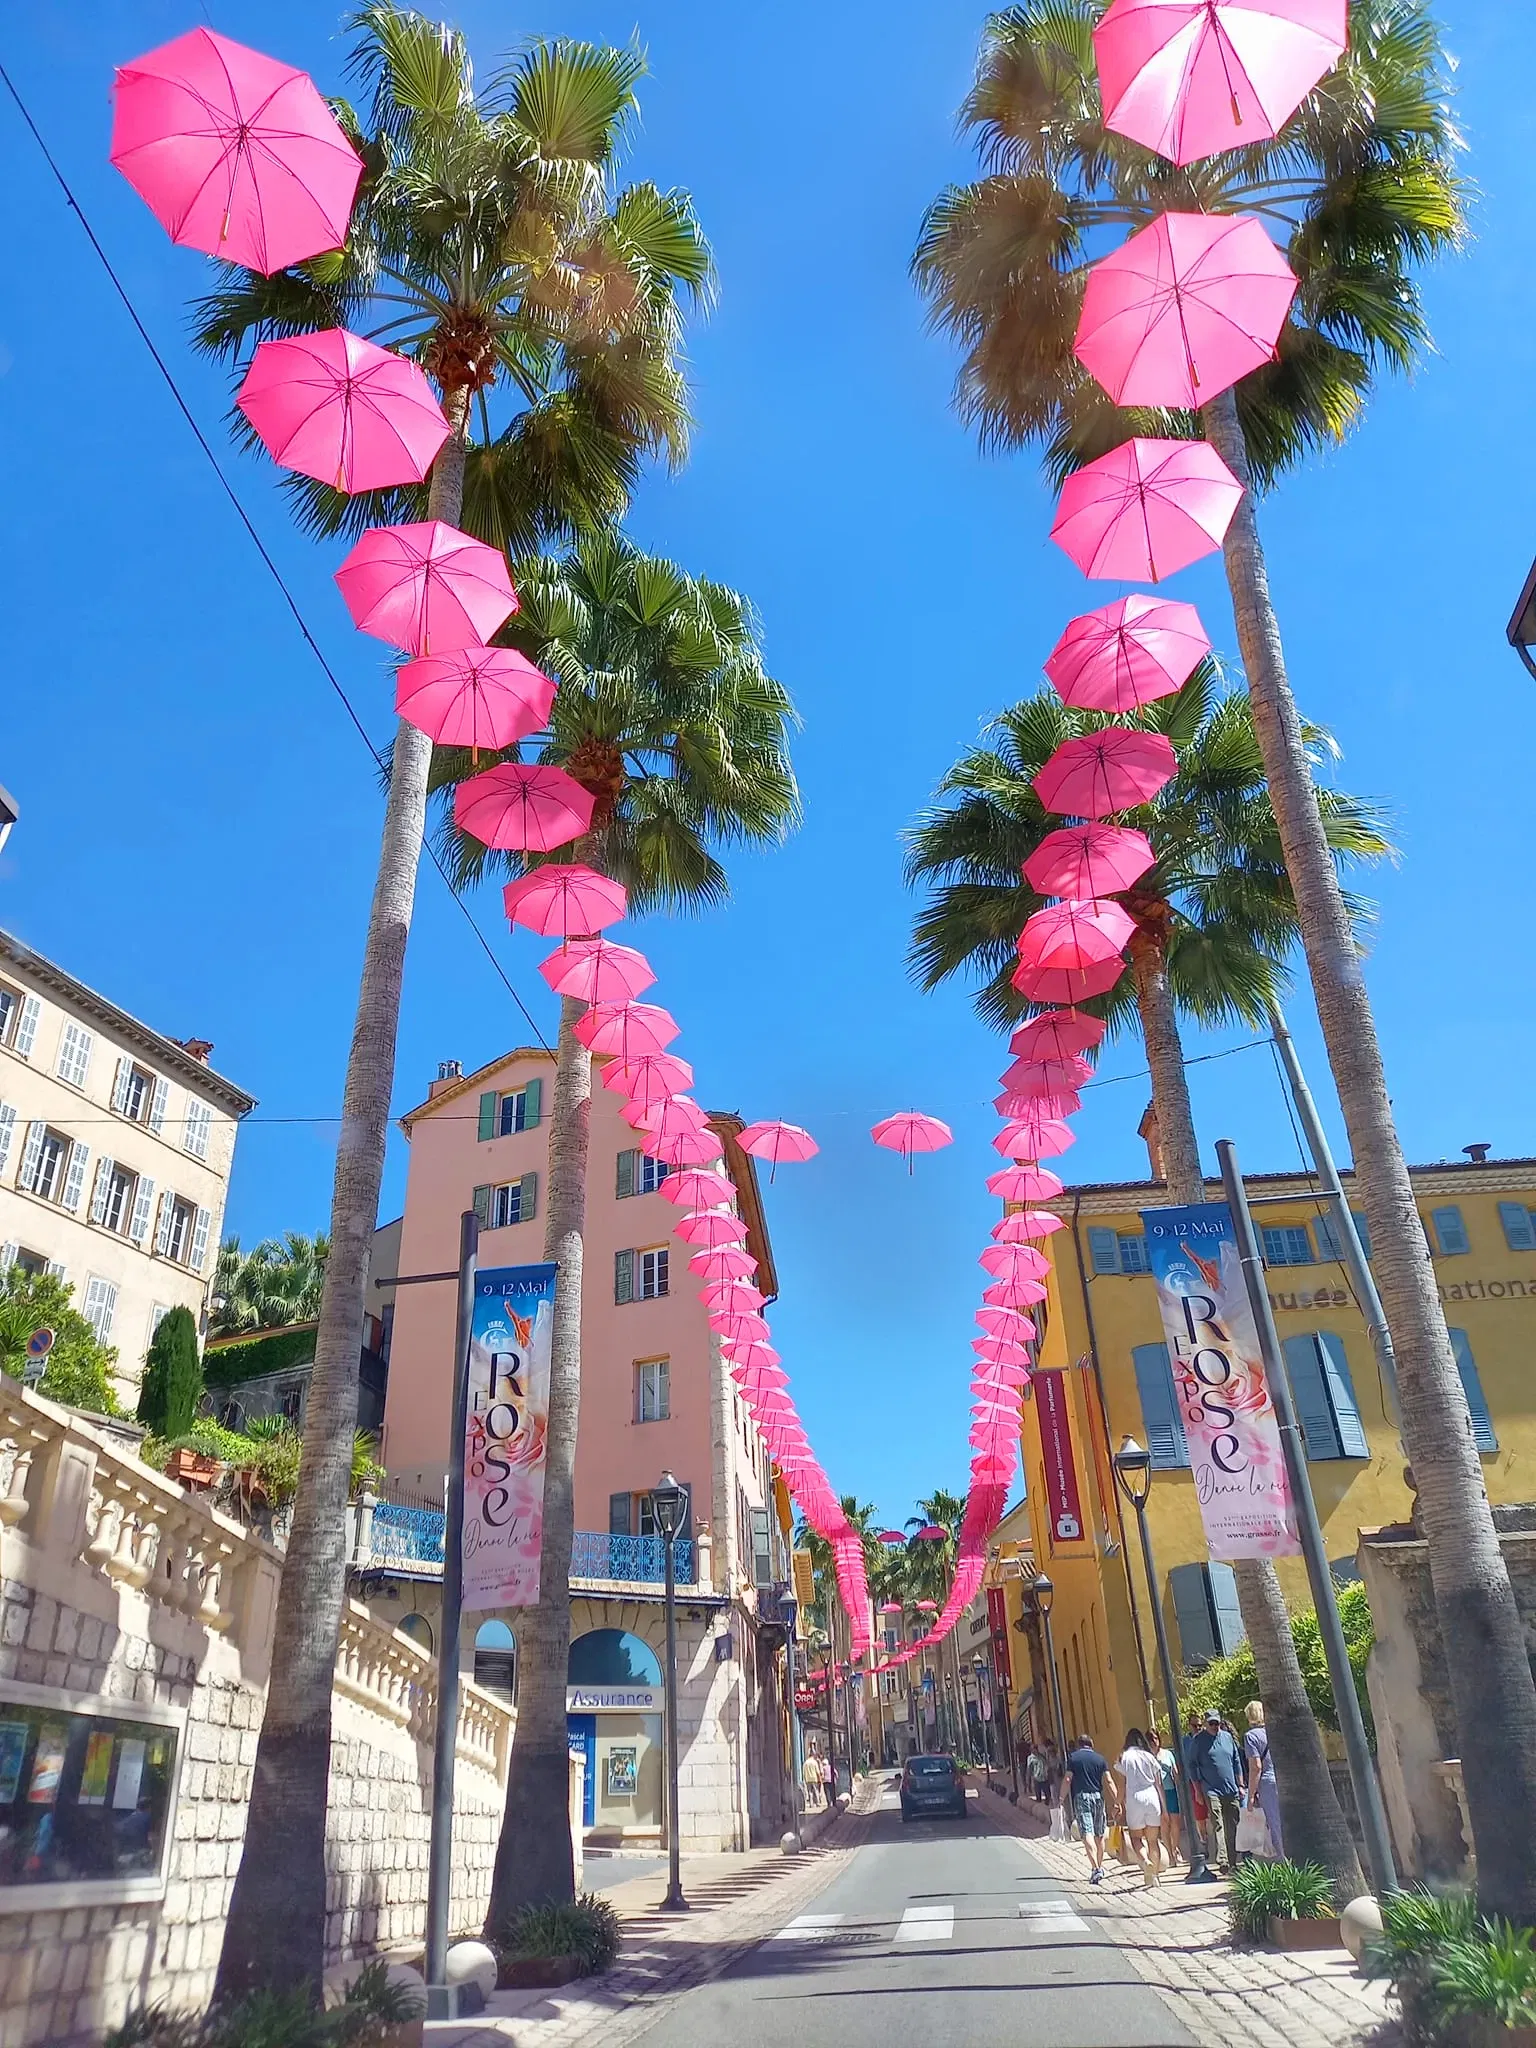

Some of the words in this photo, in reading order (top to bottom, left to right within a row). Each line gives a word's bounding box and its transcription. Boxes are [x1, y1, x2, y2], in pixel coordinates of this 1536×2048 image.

[1153, 1225, 1164, 1238] 9
[1174, 1223, 1189, 1236] 12
[1191, 1219, 1225, 1234] Mai
[483, 1285, 493, 1297] 9
[502, 1283, 514, 1295] 12
[518, 1280, 547, 1293] Mai
[573, 1690, 653, 1706] Assurance
